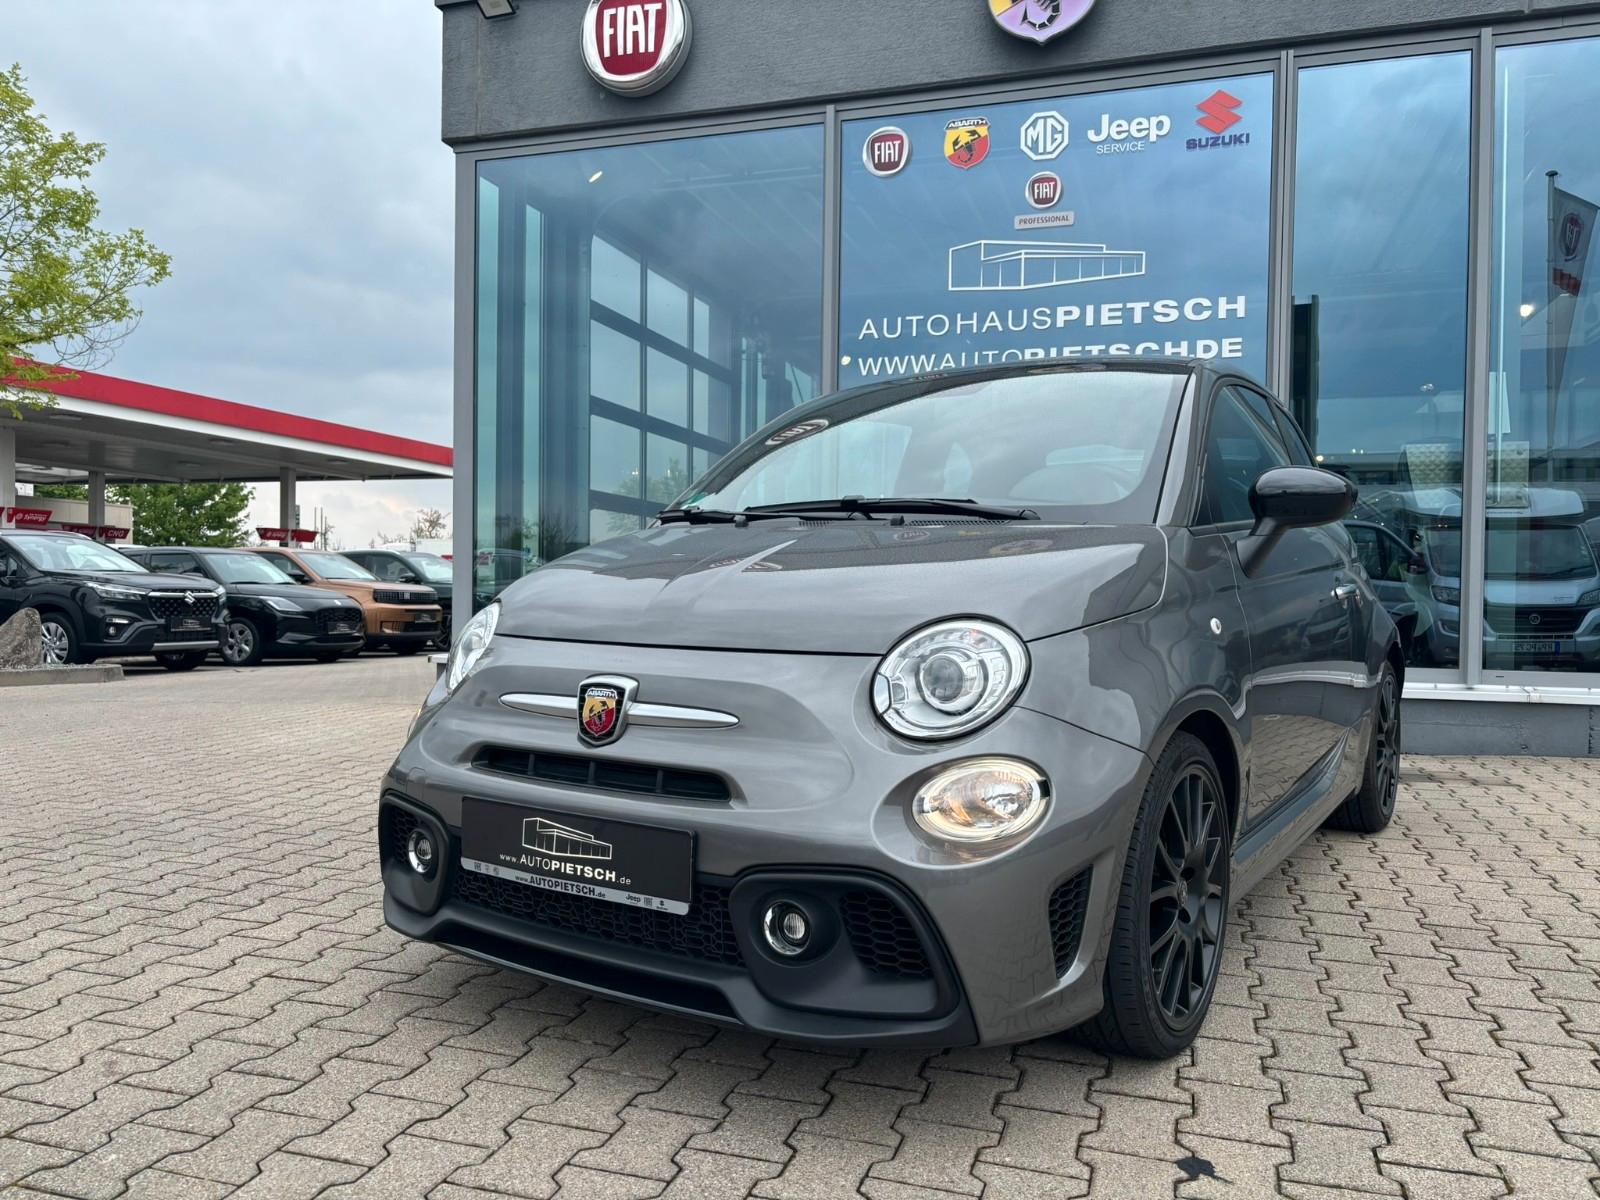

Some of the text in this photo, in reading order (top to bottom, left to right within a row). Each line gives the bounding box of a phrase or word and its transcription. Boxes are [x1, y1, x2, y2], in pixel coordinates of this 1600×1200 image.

[603, 2, 662, 58] FIAT
[948, 118, 986, 129] ABARTH
[1087, 113, 1171, 142] Jeep
[1027, 118, 1062, 154] MG
[1096, 141, 1145, 154] SERVICE
[1186, 132, 1250, 150] SUZUKI
[874, 140, 902, 164] FIAT
[1033, 181, 1056, 200] FIAT
[1018, 214, 1071, 226] PROFESSIONAL
[857, 296, 1246, 340] AUTOHAUSPIETSCH
[499, 853, 632, 886] www.AUTOPIETSCH.de
